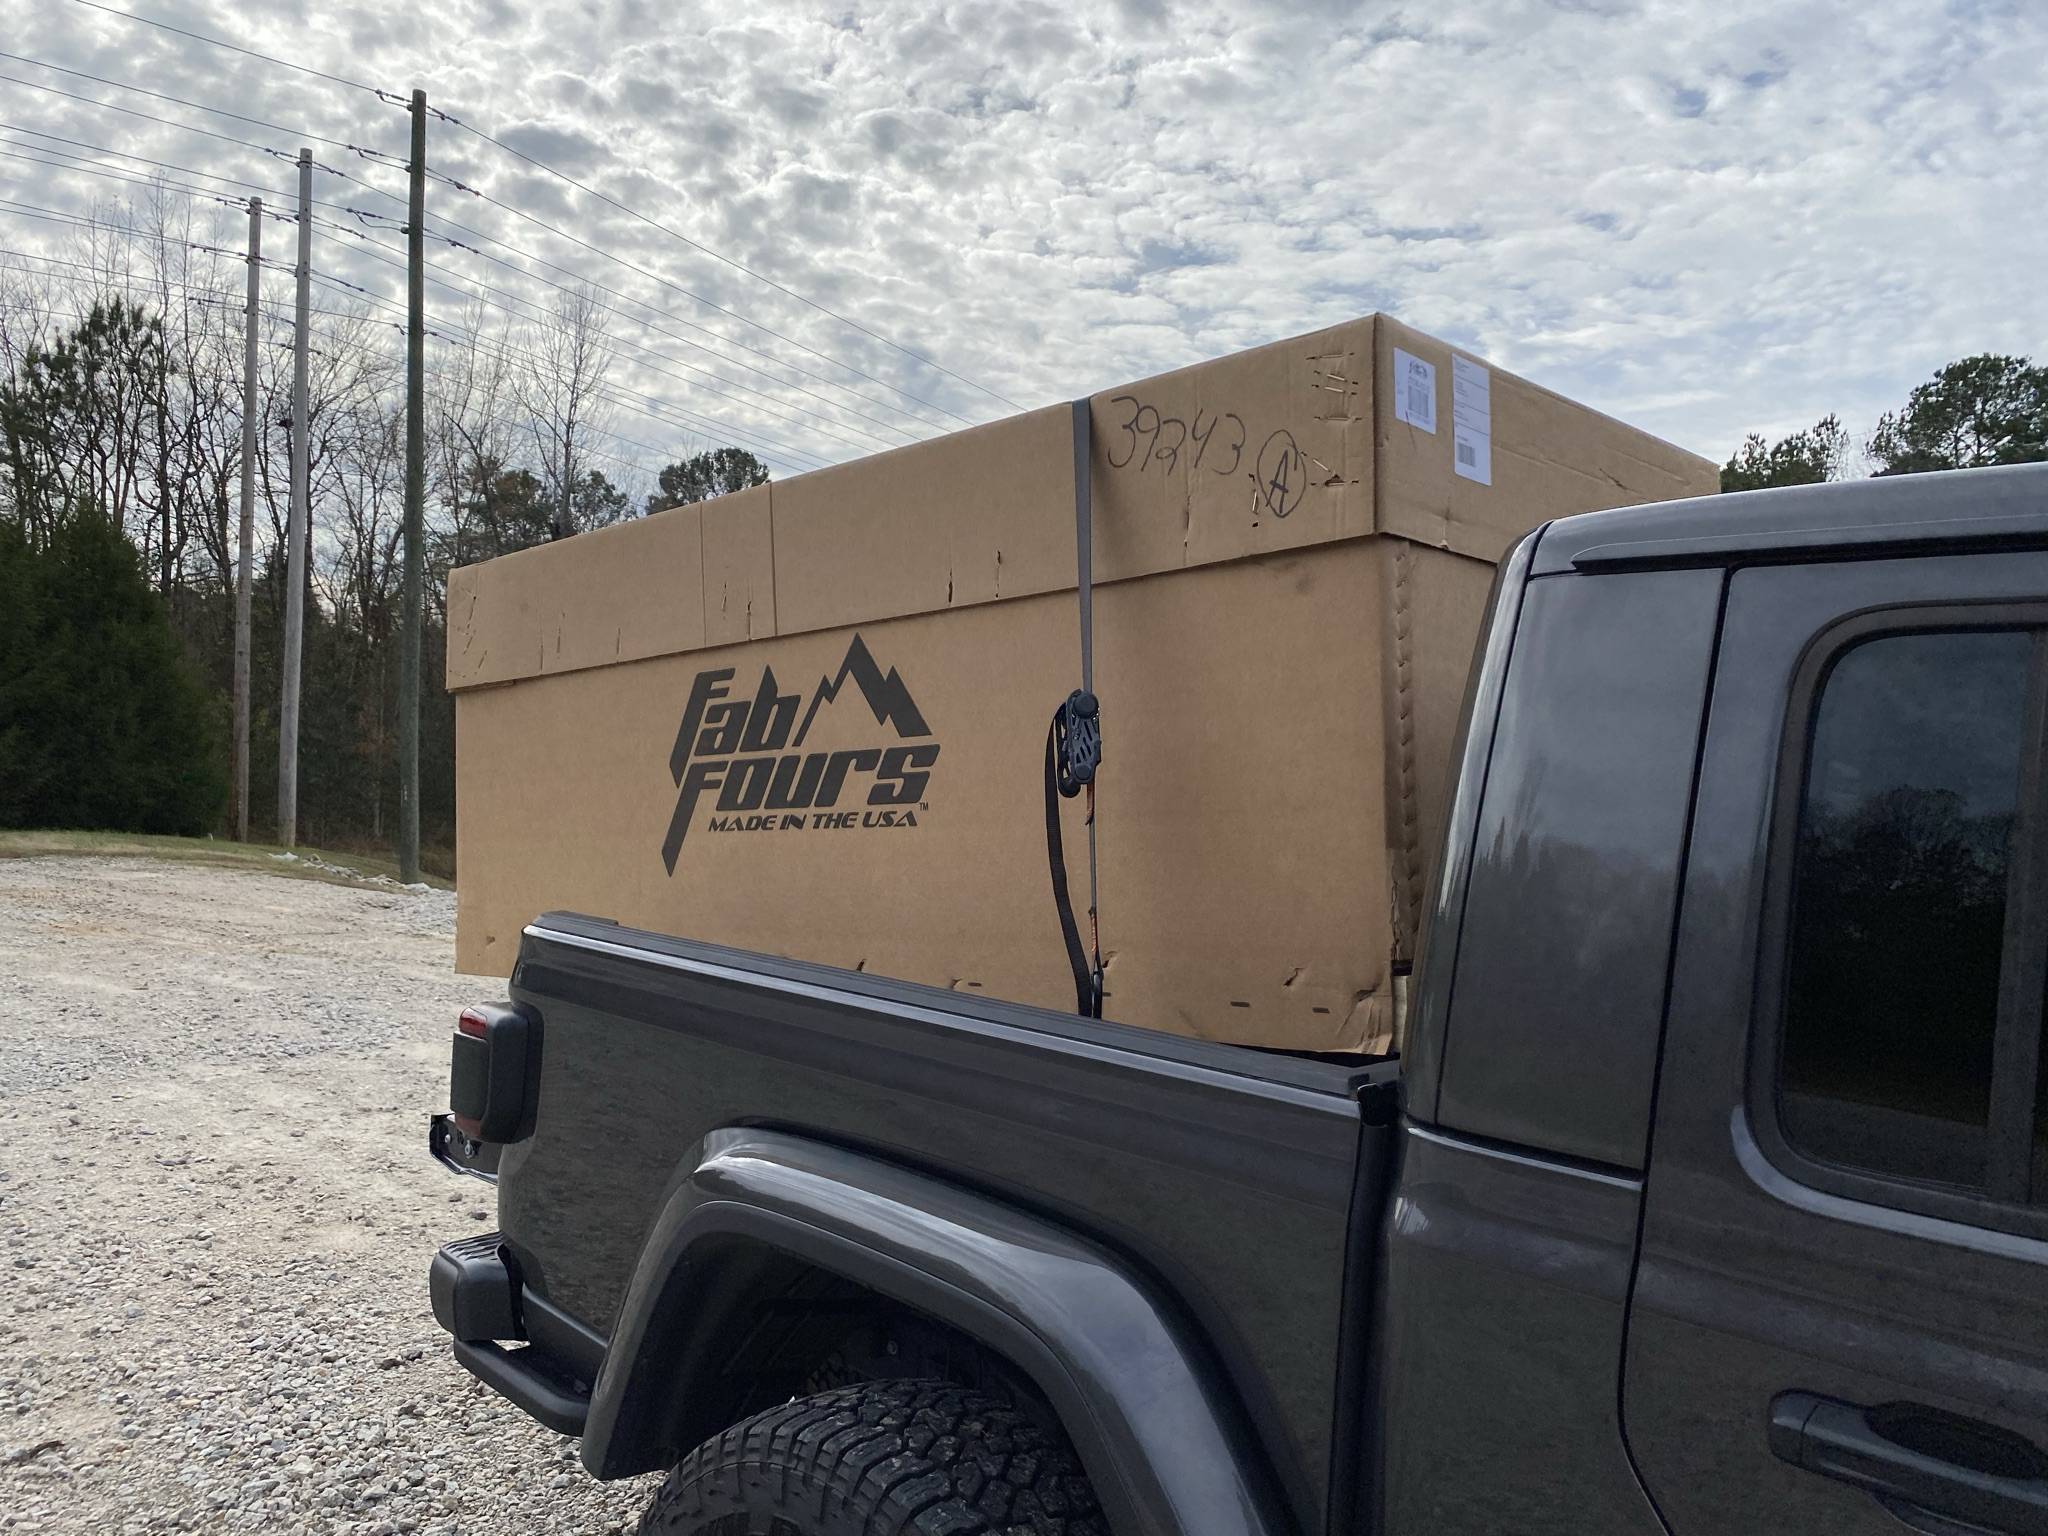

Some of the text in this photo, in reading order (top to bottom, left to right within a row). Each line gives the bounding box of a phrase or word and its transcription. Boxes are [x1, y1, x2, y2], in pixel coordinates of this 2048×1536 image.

[1108, 396, 1246, 475] 39243
[669, 664, 801, 789] Fab
[708, 810, 918, 832] MADE IN THE USA
